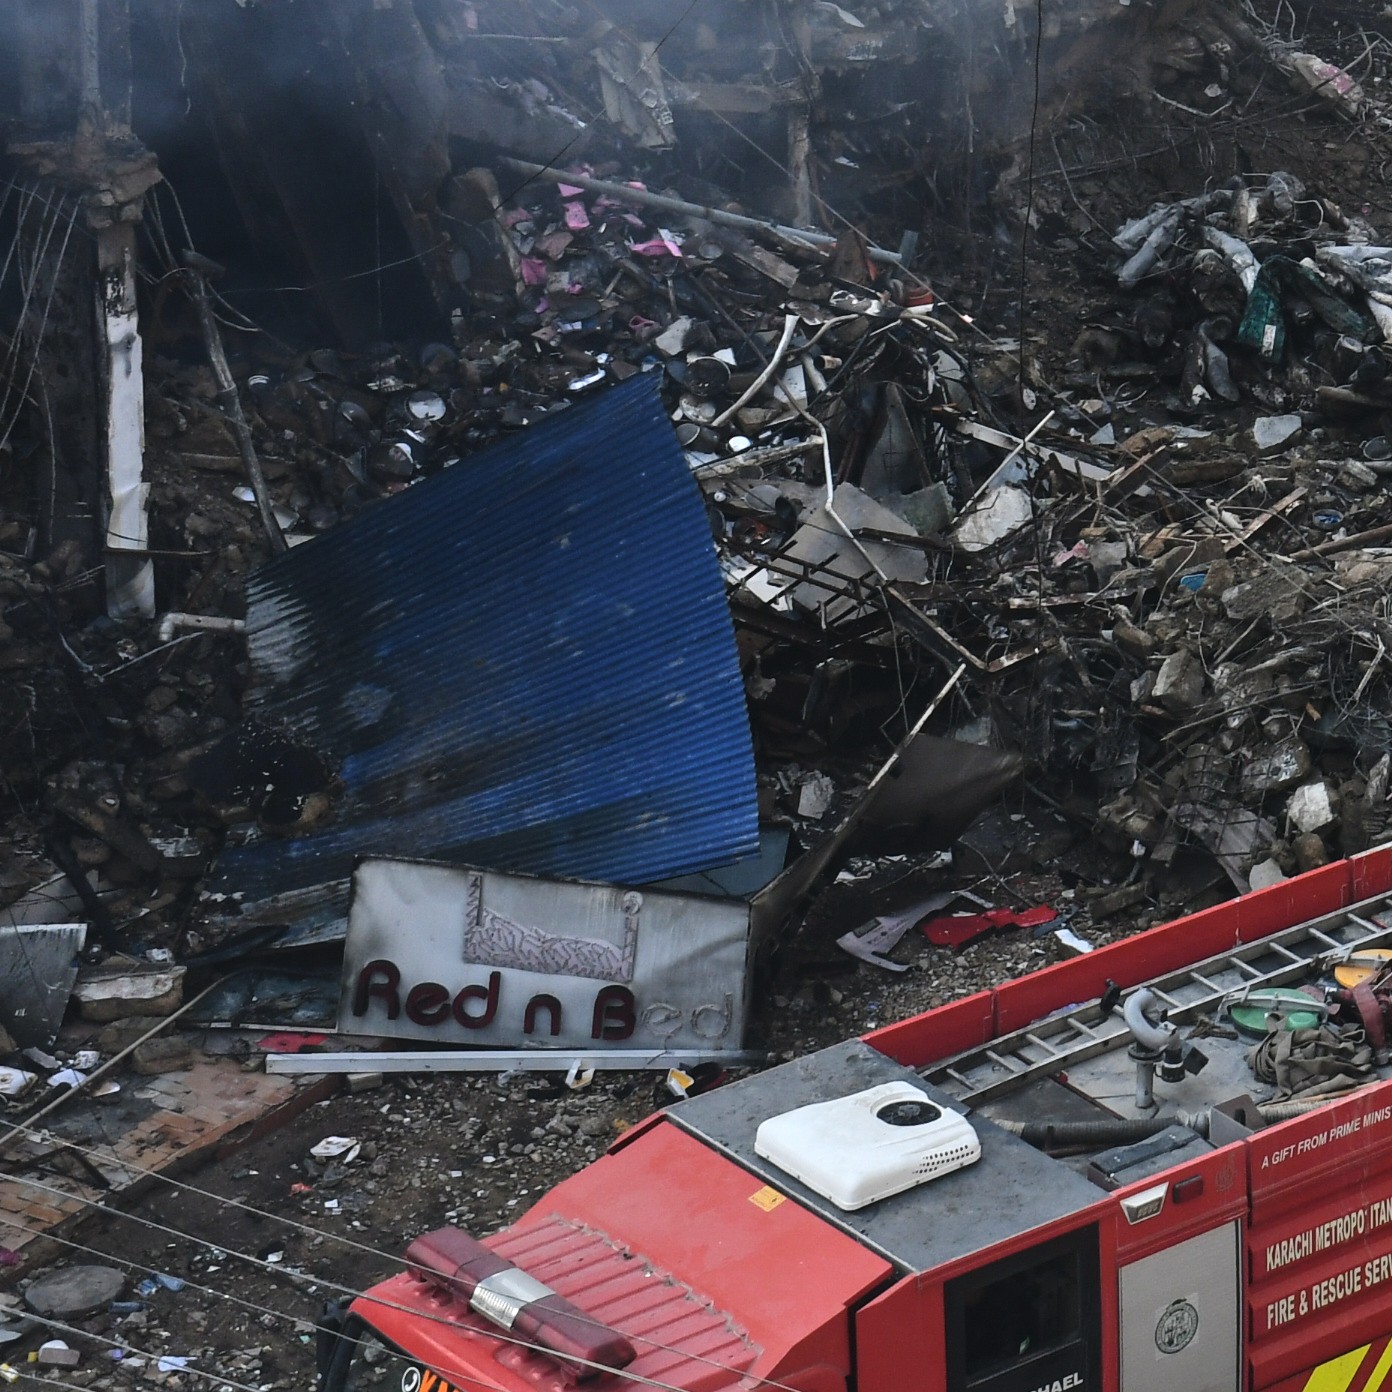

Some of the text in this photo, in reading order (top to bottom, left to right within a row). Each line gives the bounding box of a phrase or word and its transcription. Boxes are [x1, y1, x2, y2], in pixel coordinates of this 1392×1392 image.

[352, 958, 501, 1029] Red
[523, 993, 562, 1037] n
[1261, 1155, 1269, 1170] A
[1271, 1144, 1297, 1166] GIFT
[1297, 1133, 1327, 1154] FROM
[1329, 1117, 1361, 1142] PRIME
[1266, 1233, 1313, 1272] KARACHI
[1267, 1296, 1296, 1330] FIRE
[1299, 1293, 1308, 1316] &
[1312, 1269, 1362, 1312] RESCUE
